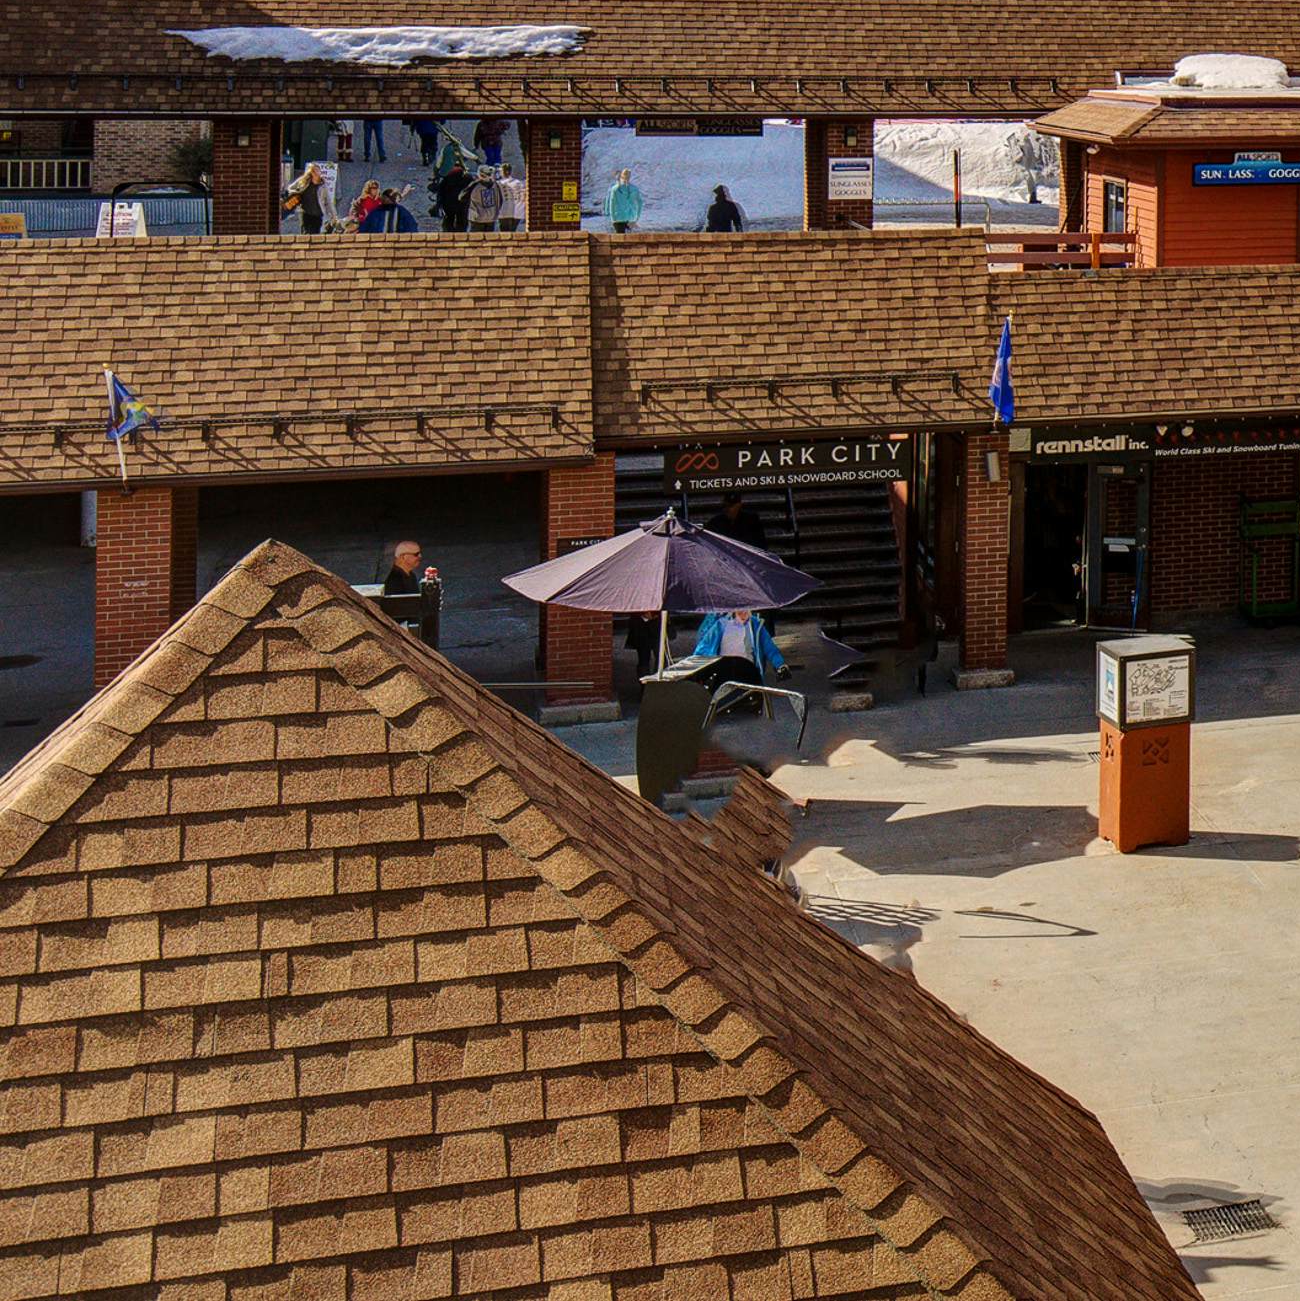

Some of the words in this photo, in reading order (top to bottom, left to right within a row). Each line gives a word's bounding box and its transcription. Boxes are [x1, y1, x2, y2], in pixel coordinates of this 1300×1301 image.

[738, 446, 815, 468] PARK
[831, 442, 901, 463] CITY
[1036, 434, 1128, 455] rennstall
[1129, 438, 1150, 450] inc.
[1155, 448, 1178, 457] World
[1180, 447, 1200, 455] Class
[1203, 445, 1215, 454] Ski
[1216, 445, 1231, 453] and
[1233, 442, 1277, 452] Snowboard
[690, 478, 733, 490] TICKETS
[735, 477, 758, 486] AND
[760, 475, 776, 486] SKI
[778, 475, 786, 485] &
[787, 471, 856, 484] SNOWBOARD
[858, 468, 903, 480] SCHOOL
